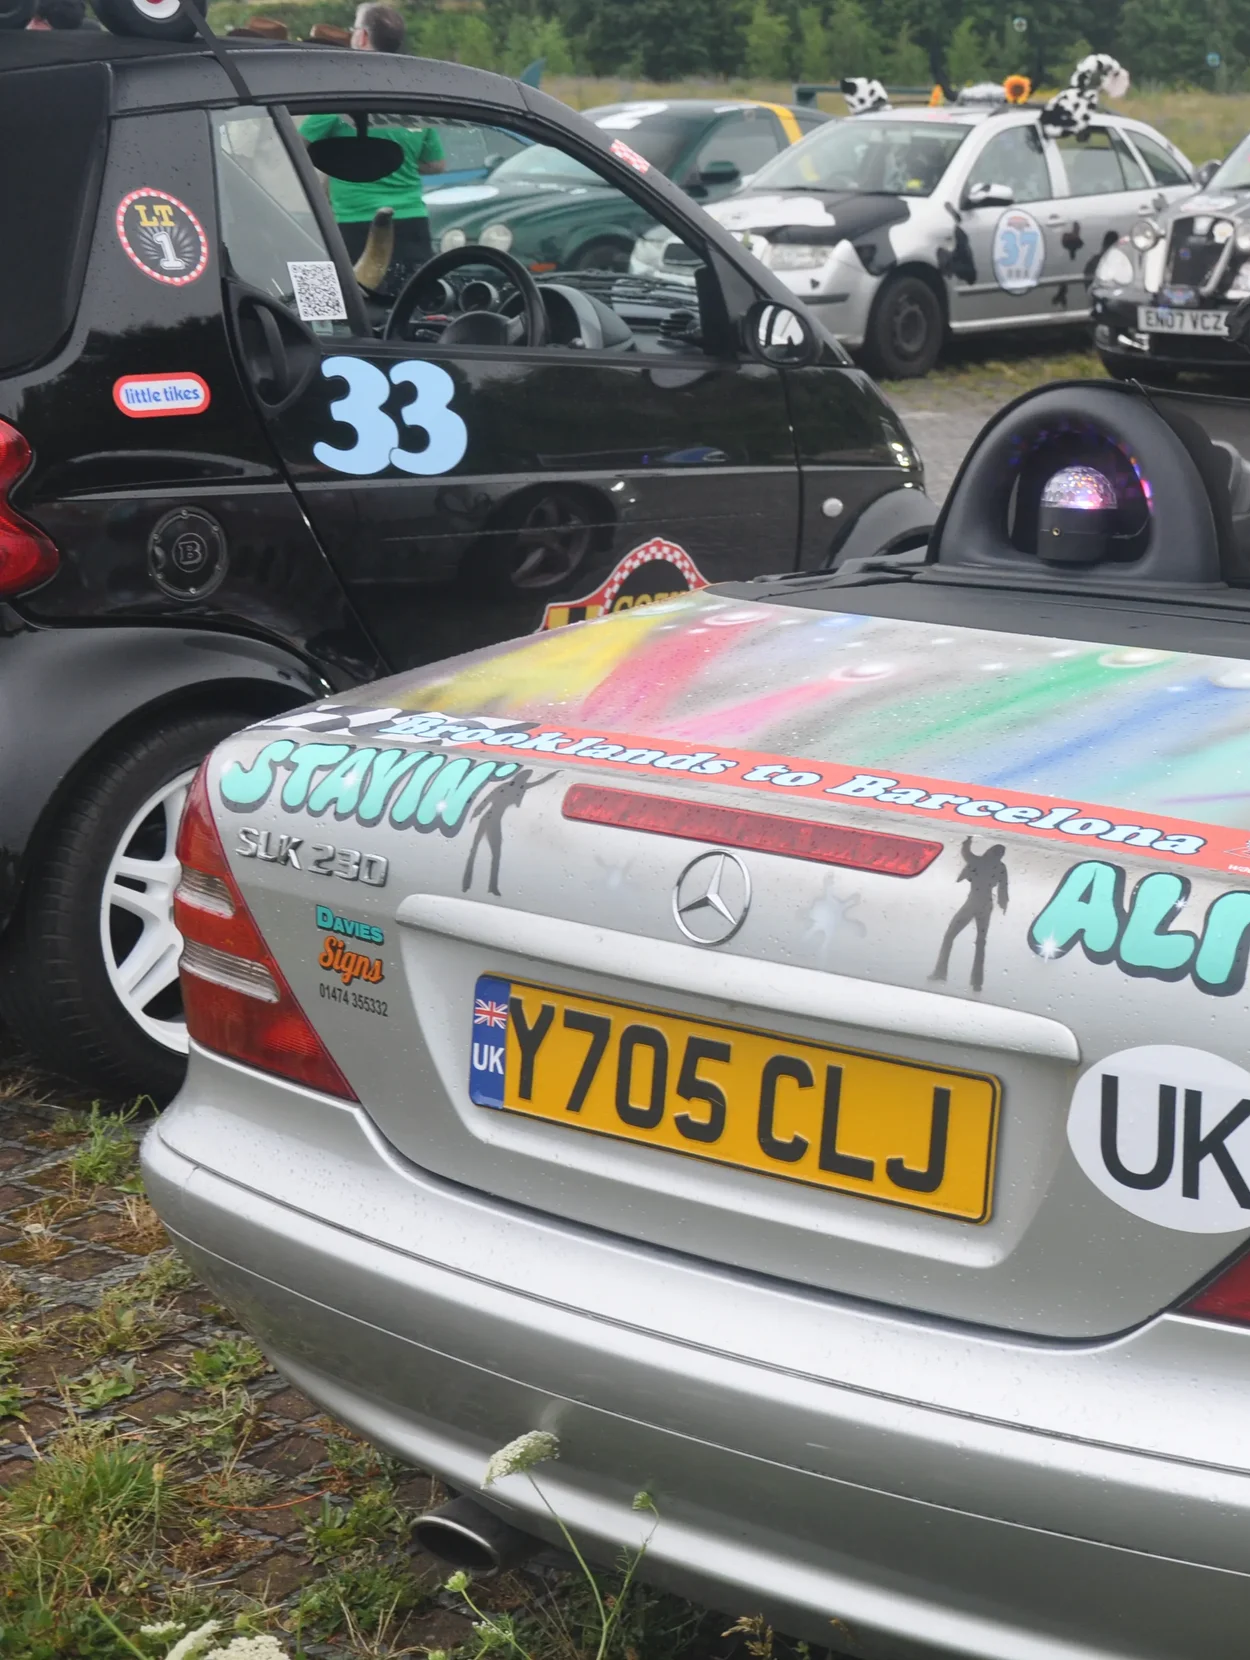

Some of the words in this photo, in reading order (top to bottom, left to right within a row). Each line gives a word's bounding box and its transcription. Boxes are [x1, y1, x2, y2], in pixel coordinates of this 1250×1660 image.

[134, 205, 176, 227] LT
[153, 231, 186, 271] 1
[999, 230, 1039, 269] 37
[1190, 312, 1223, 331] VCZ
[125, 387, 161, 404] little
[163, 385, 200, 402] tikes
[313, 356, 468, 475] 33
[178, 541, 202, 565] B
[376, 716, 739, 775] Brooklands
[740, 763, 823, 788] to
[823, 774, 1208, 856] Barcelona
[234, 826, 304, 871] SLK
[308, 843, 389, 888] 230
[316, 904, 385, 945] DAVIES
[318, 935, 385, 986] Signs
[319, 983, 349, 1005] 01474
[473, 1043, 505, 1076] UK
[509, 997, 733, 1144] Y705
[757, 1054, 951, 1194] CLJ
